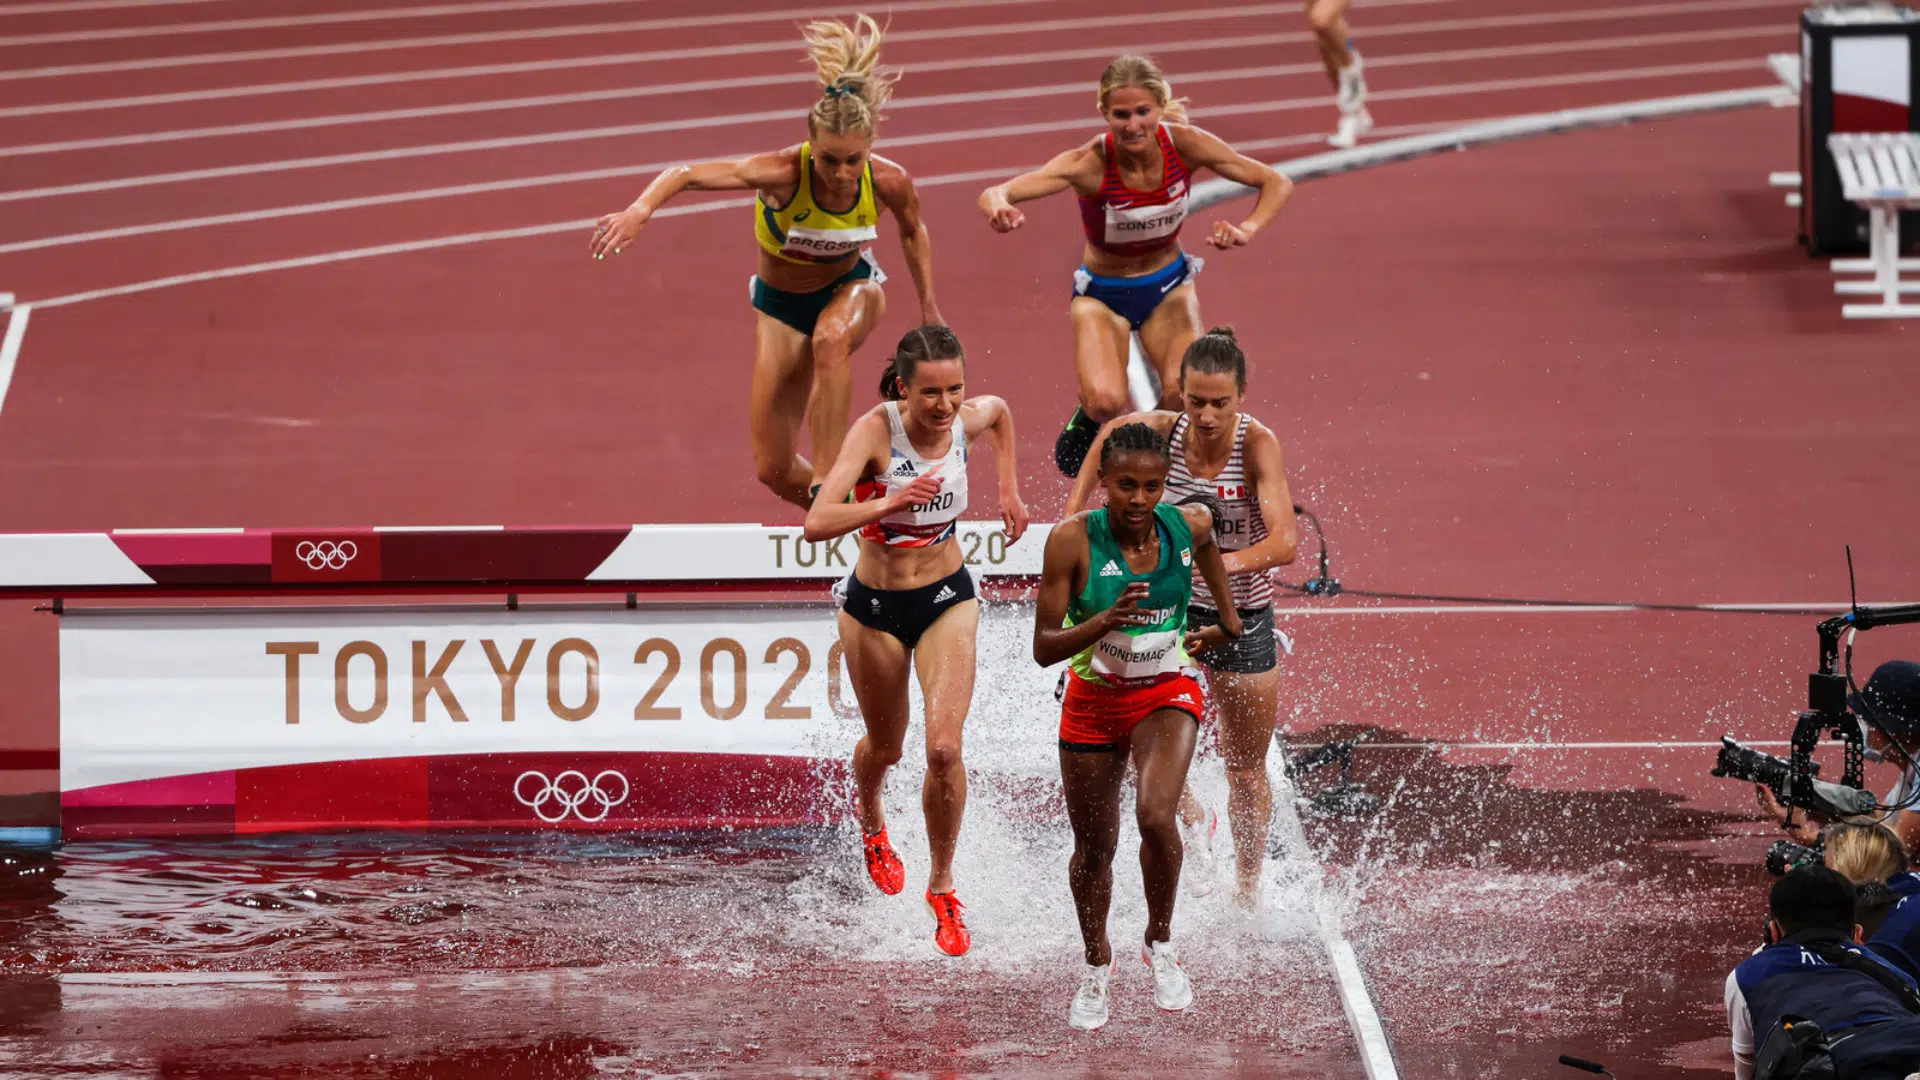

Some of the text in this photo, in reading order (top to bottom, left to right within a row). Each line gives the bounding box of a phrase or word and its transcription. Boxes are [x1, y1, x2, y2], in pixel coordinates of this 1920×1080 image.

[1222, 518, 1247, 535] DE
[963, 530, 1007, 565] 20
[265, 637, 600, 725] TOKYO
